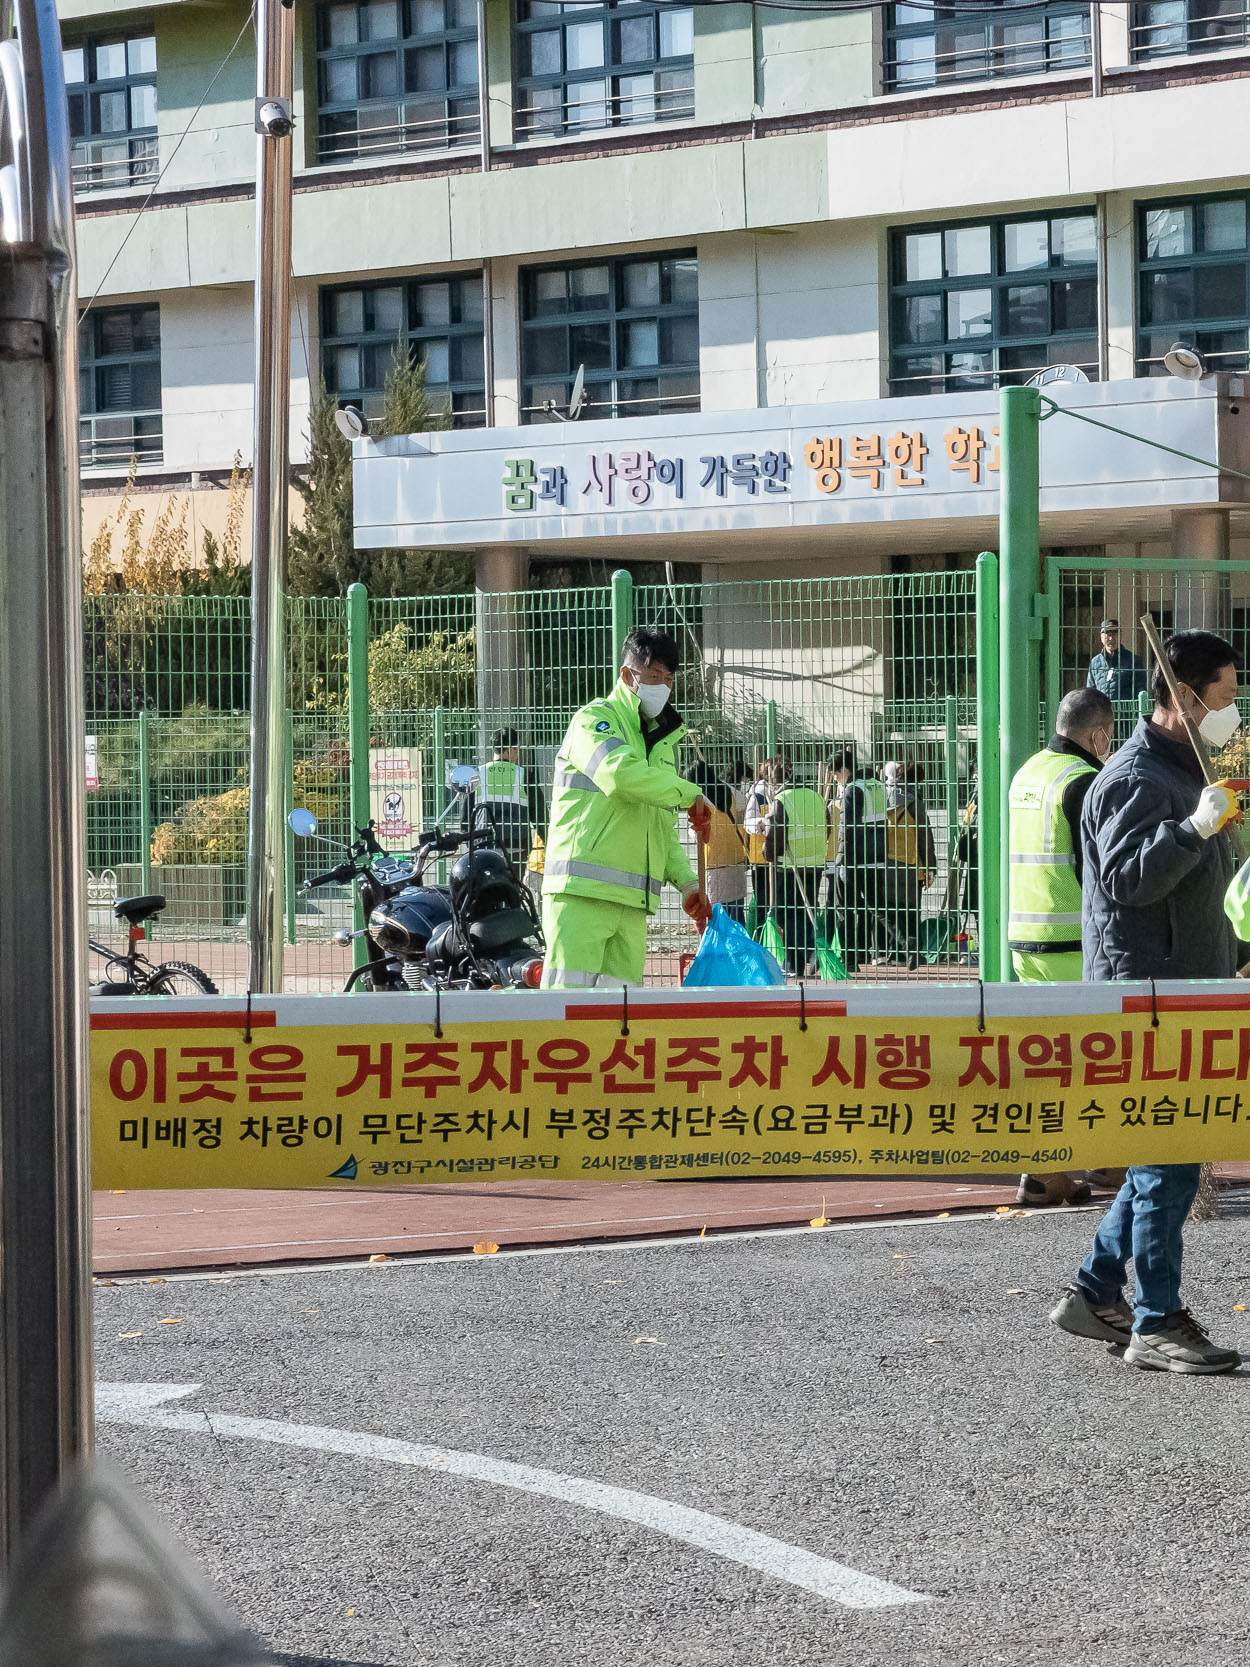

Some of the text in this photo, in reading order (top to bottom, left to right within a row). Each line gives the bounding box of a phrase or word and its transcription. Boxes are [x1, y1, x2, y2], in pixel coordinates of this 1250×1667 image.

[1054, 366, 1066, 378] 12
[501, 426, 1000, 510] 꿈과 사랑이 가득한 행복한 학
[108, 1045, 307, 1103] 이곳은
[336, 1033, 789, 1099] 거주자우선주차
[811, 1030, 933, 1090] 시행
[119, 1116, 222, 1149] 미배정
[239, 1113, 343, 1147] 차량이
[358, 1107, 530, 1144] 무단주차시
[545, 1102, 913, 1140] 부정주차단속(요금부과)
[929, 1103, 956, 1135] 및
[972, 1100, 1065, 1134] 견인될
[1078, 1099, 1106, 1130] 수
[369, 1153, 560, 1174] 광진구시설관리공단
[581, 1146, 1073, 1171] 24시간통합관제센터(02-2049-4595), 주차사업팀(02-2049-4540)
